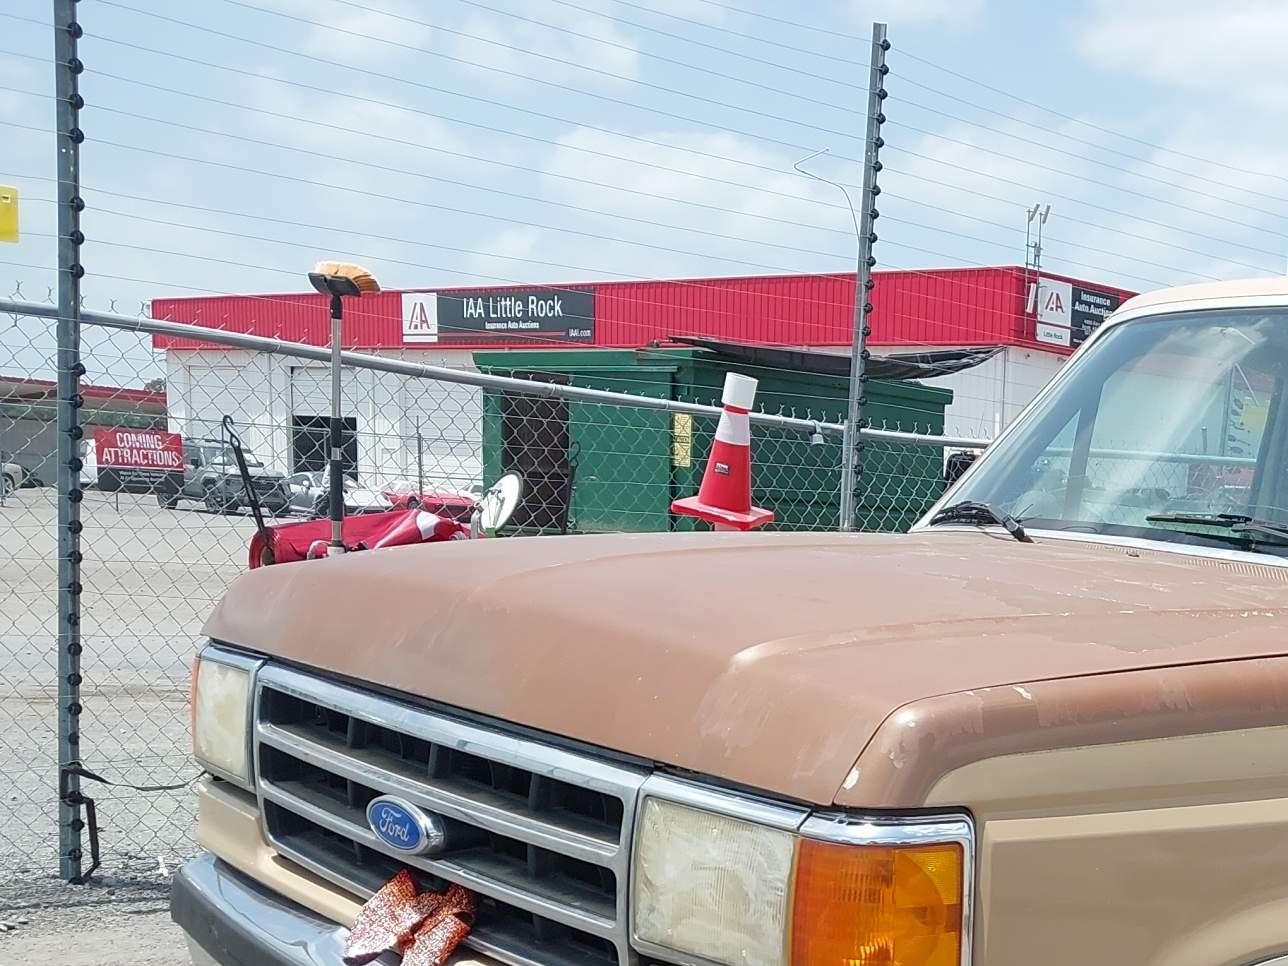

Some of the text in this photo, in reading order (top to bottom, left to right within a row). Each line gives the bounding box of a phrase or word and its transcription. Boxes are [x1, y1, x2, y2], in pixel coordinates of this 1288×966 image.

[463, 295, 563, 318] IAA Little Rock
[1081, 292, 1111, 305] Insurance
[1074, 301, 1112, 316] Auto Auction
[485, 319, 540, 330] Insurance Auto Auctions
[116, 432, 162, 449] COMING
[102, 448, 181, 466] ATTRACTIONS
[379, 807, 410, 841] Ford
